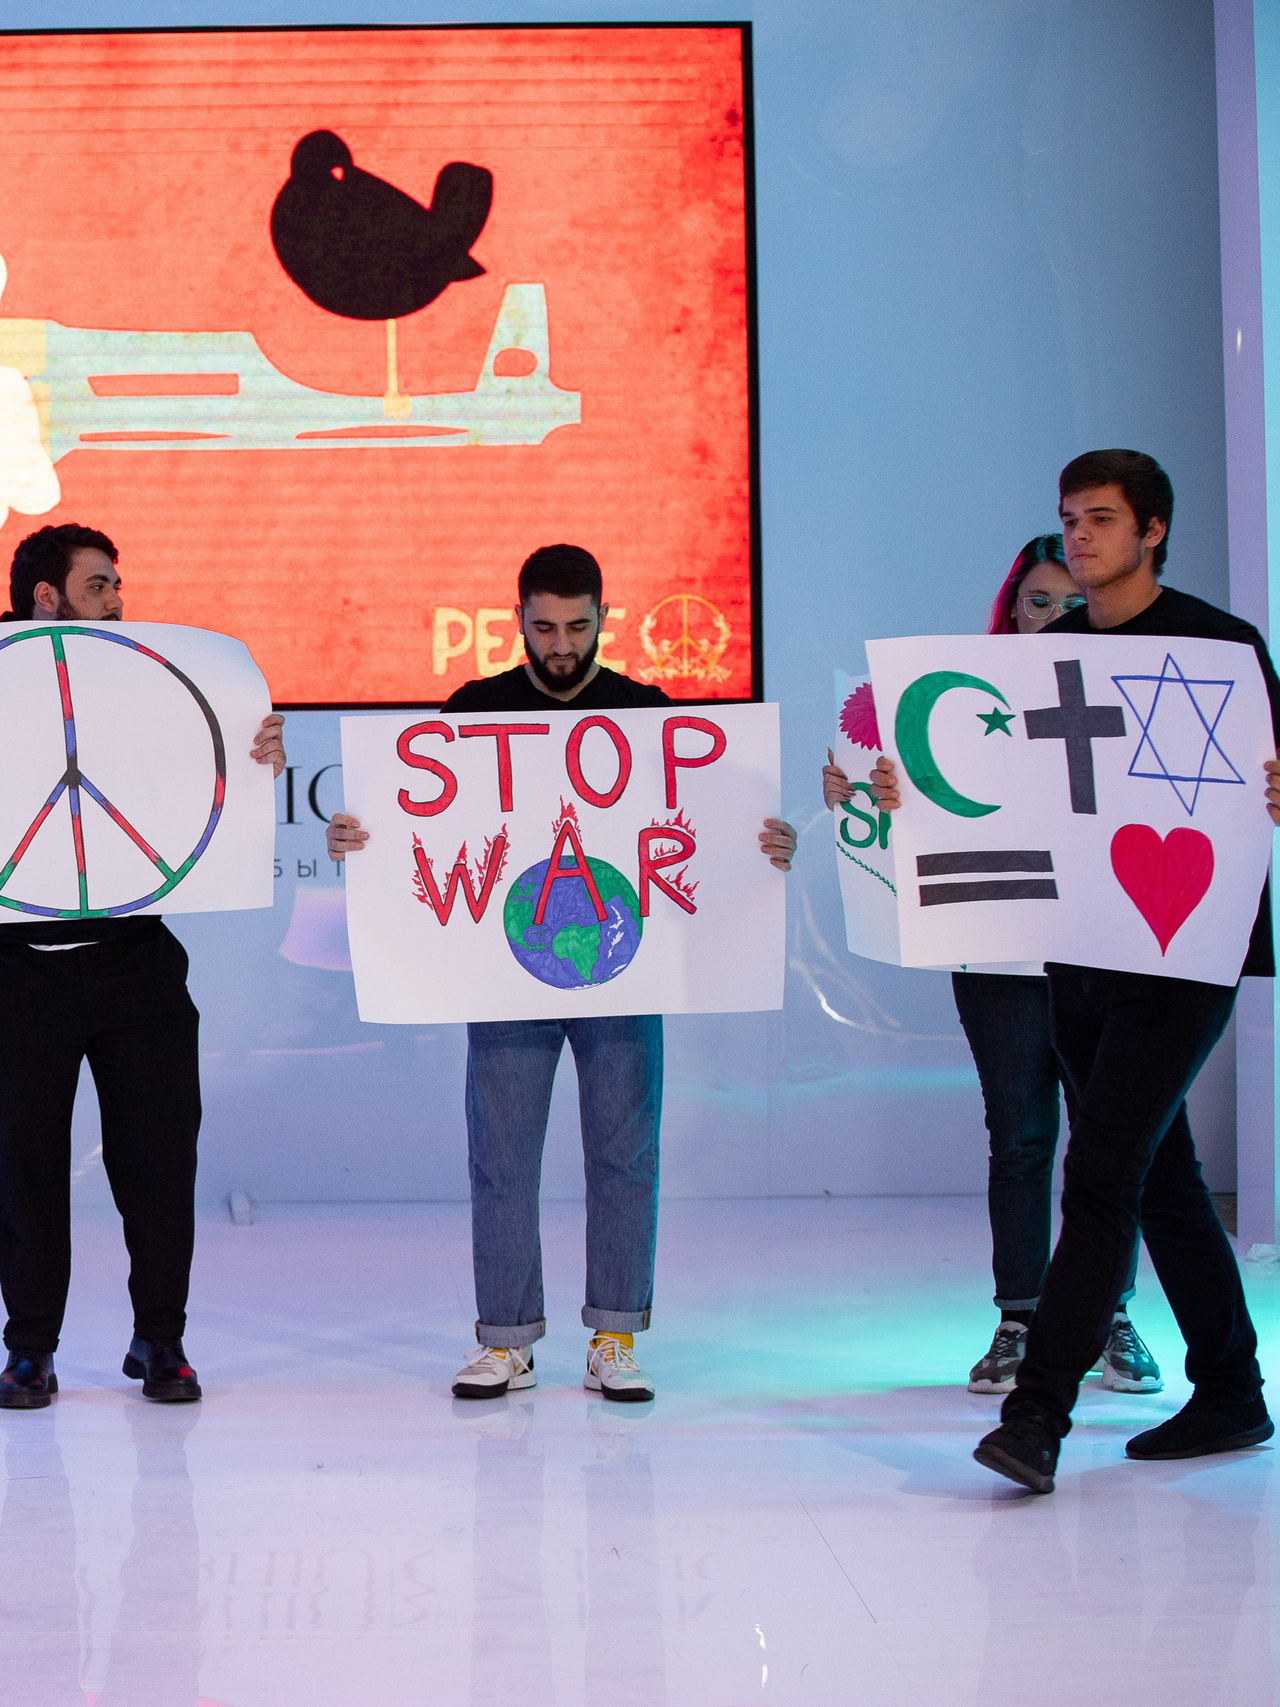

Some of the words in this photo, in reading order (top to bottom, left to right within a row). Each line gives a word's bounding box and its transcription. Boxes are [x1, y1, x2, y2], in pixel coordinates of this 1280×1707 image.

[432, 606, 626, 678] PEE
[396, 715, 727, 818] STOP
[413, 819, 698, 927] WAR
